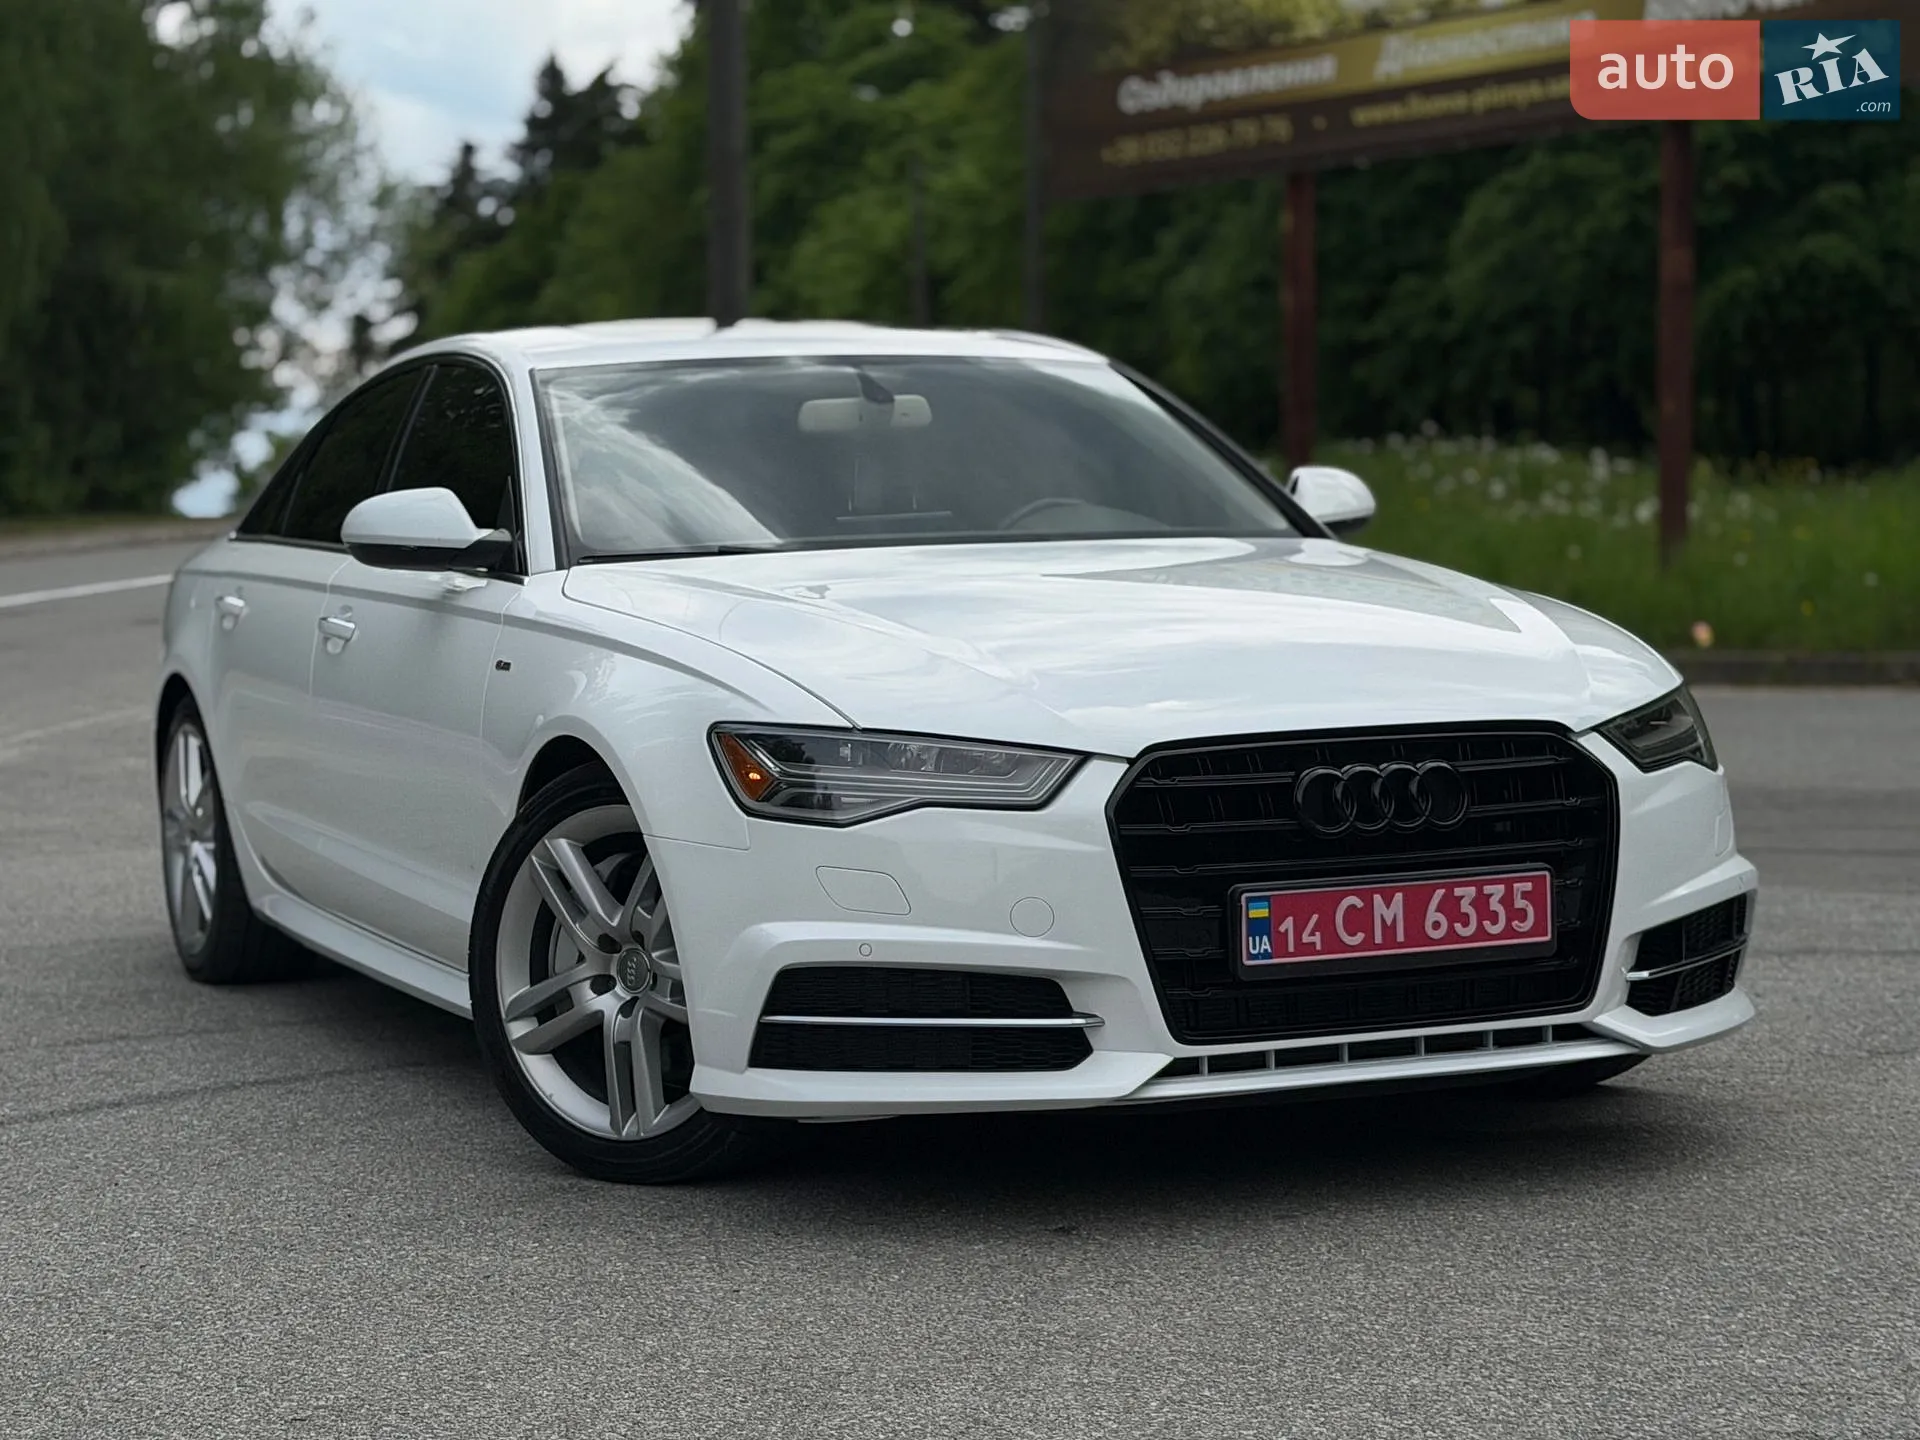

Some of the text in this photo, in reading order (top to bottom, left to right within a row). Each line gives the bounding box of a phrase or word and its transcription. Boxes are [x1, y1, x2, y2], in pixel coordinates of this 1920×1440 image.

[1278, 882, 1535, 952] 14 CM 6335
[1248, 936, 1272, 955] UA
